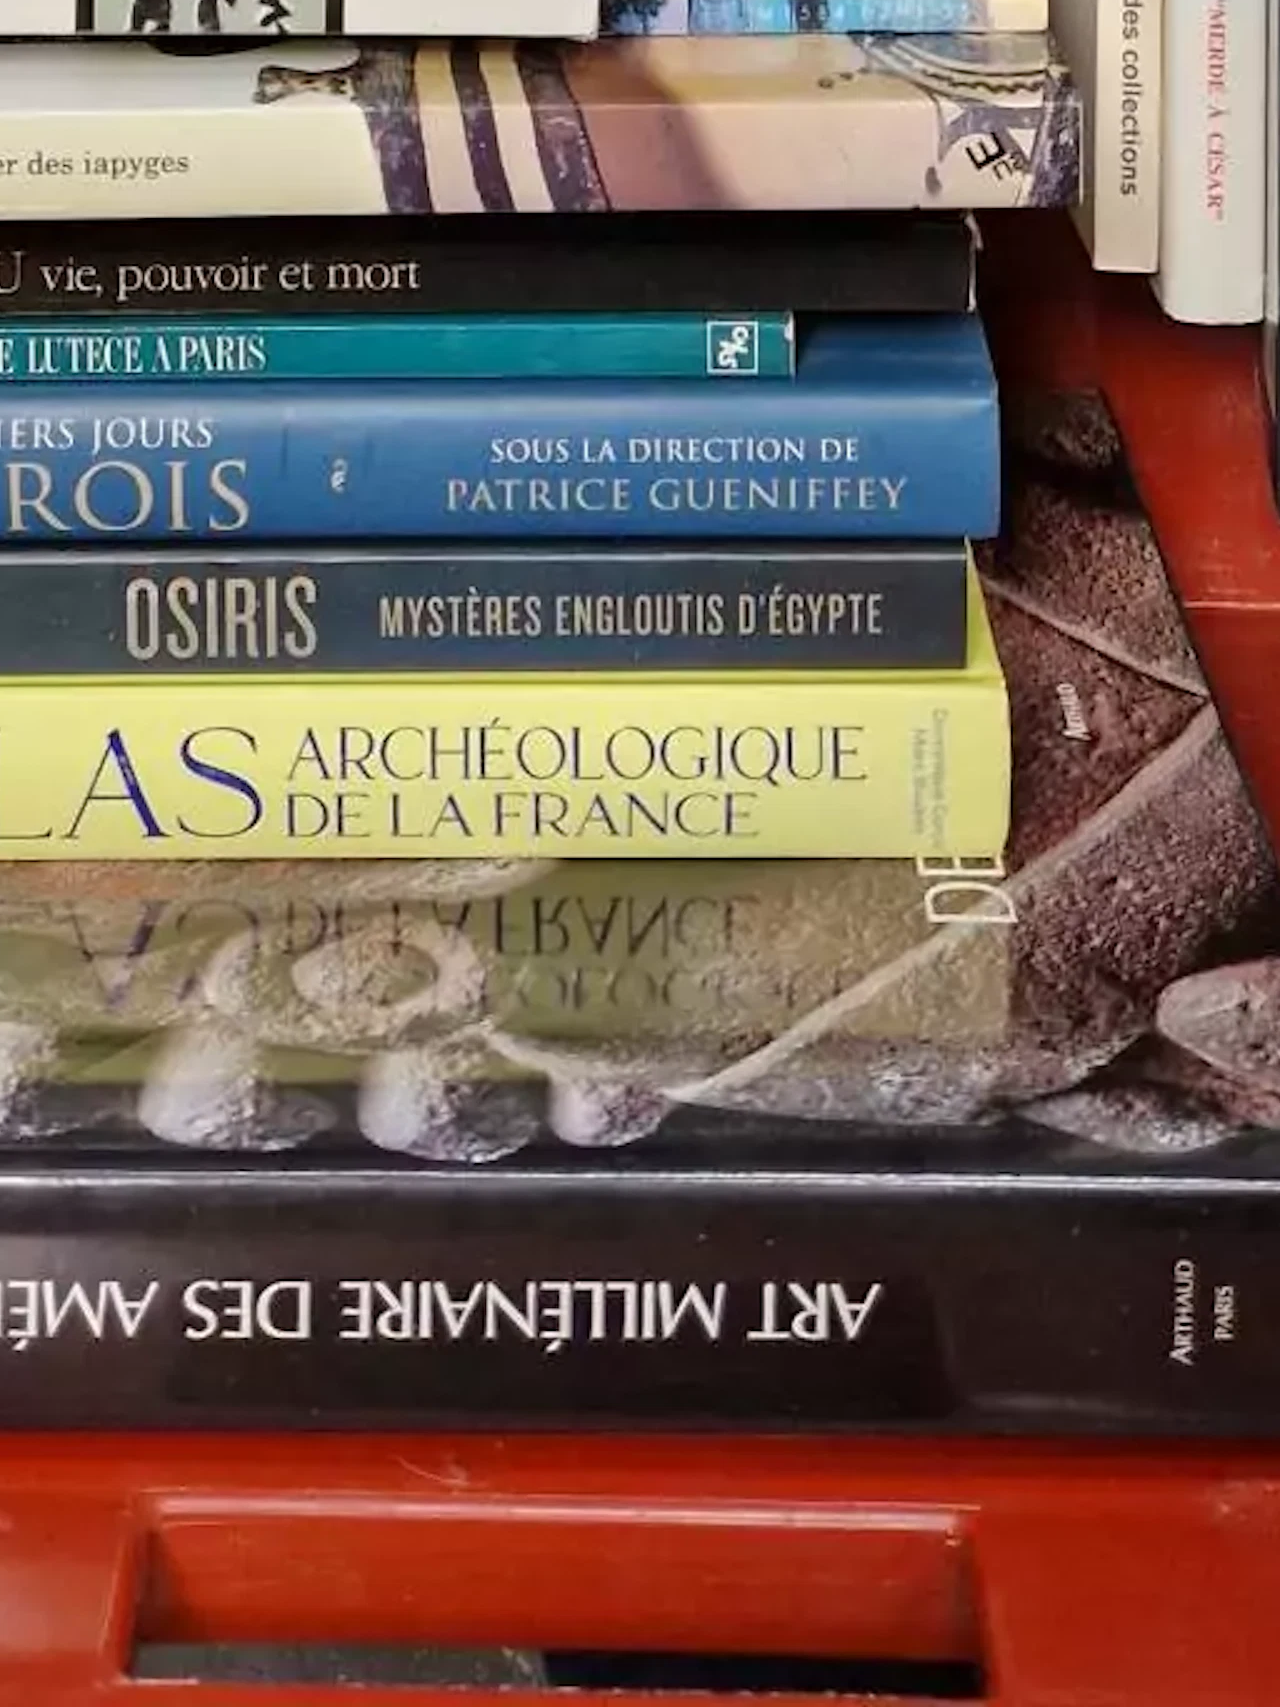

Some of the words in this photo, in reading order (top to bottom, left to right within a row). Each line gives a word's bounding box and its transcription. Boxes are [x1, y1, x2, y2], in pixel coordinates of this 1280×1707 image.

[1120, 48, 1148, 198] collections
[26, 149, 74, 176] des
[82, 149, 191, 181] iapyges
[40, 260, 106, 298] vie,
[115, 258, 269, 302] pouvoir
[277, 260, 316, 292] et
[324, 259, 422, 293] mort
[26, 335, 144, 375] LUTECE
[151, 337, 174, 372] A
[177, 333, 268, 373] PARIS
[91, 416, 215, 454] JOURS
[490, 437, 570, 465] SOUS
[581, 437, 617, 464] LA
[628, 436, 807, 464] DIRECTION
[820, 436, 860, 463] DE
[3, 459, 252, 536] ROIS
[446, 477, 632, 514] PATRICE
[648, 476, 909, 513] GUENIFFEY
[124, 575, 320, 662] OSIRIS
[378, 587, 544, 639] MYSTÈRES
[554, 591, 727, 638] ENGLOUTIS
[737, 585, 884, 637] D'ÉGYPTE
[286, 718, 869, 787] ARCHÉOLOGIQUE
[286, 792, 371, 839] DE
[388, 792, 466, 839] LA
[492, 791, 762, 839] FRANCE
[182, 1277, 315, 1342] DES
[337, 1279, 727, 1358] MILLÉNAIRE
[745, 1280, 882, 1343] ART
[1168, 1257, 1195, 1367] ARTHAUD
[1212, 1284, 1236, 1341] PARIS
